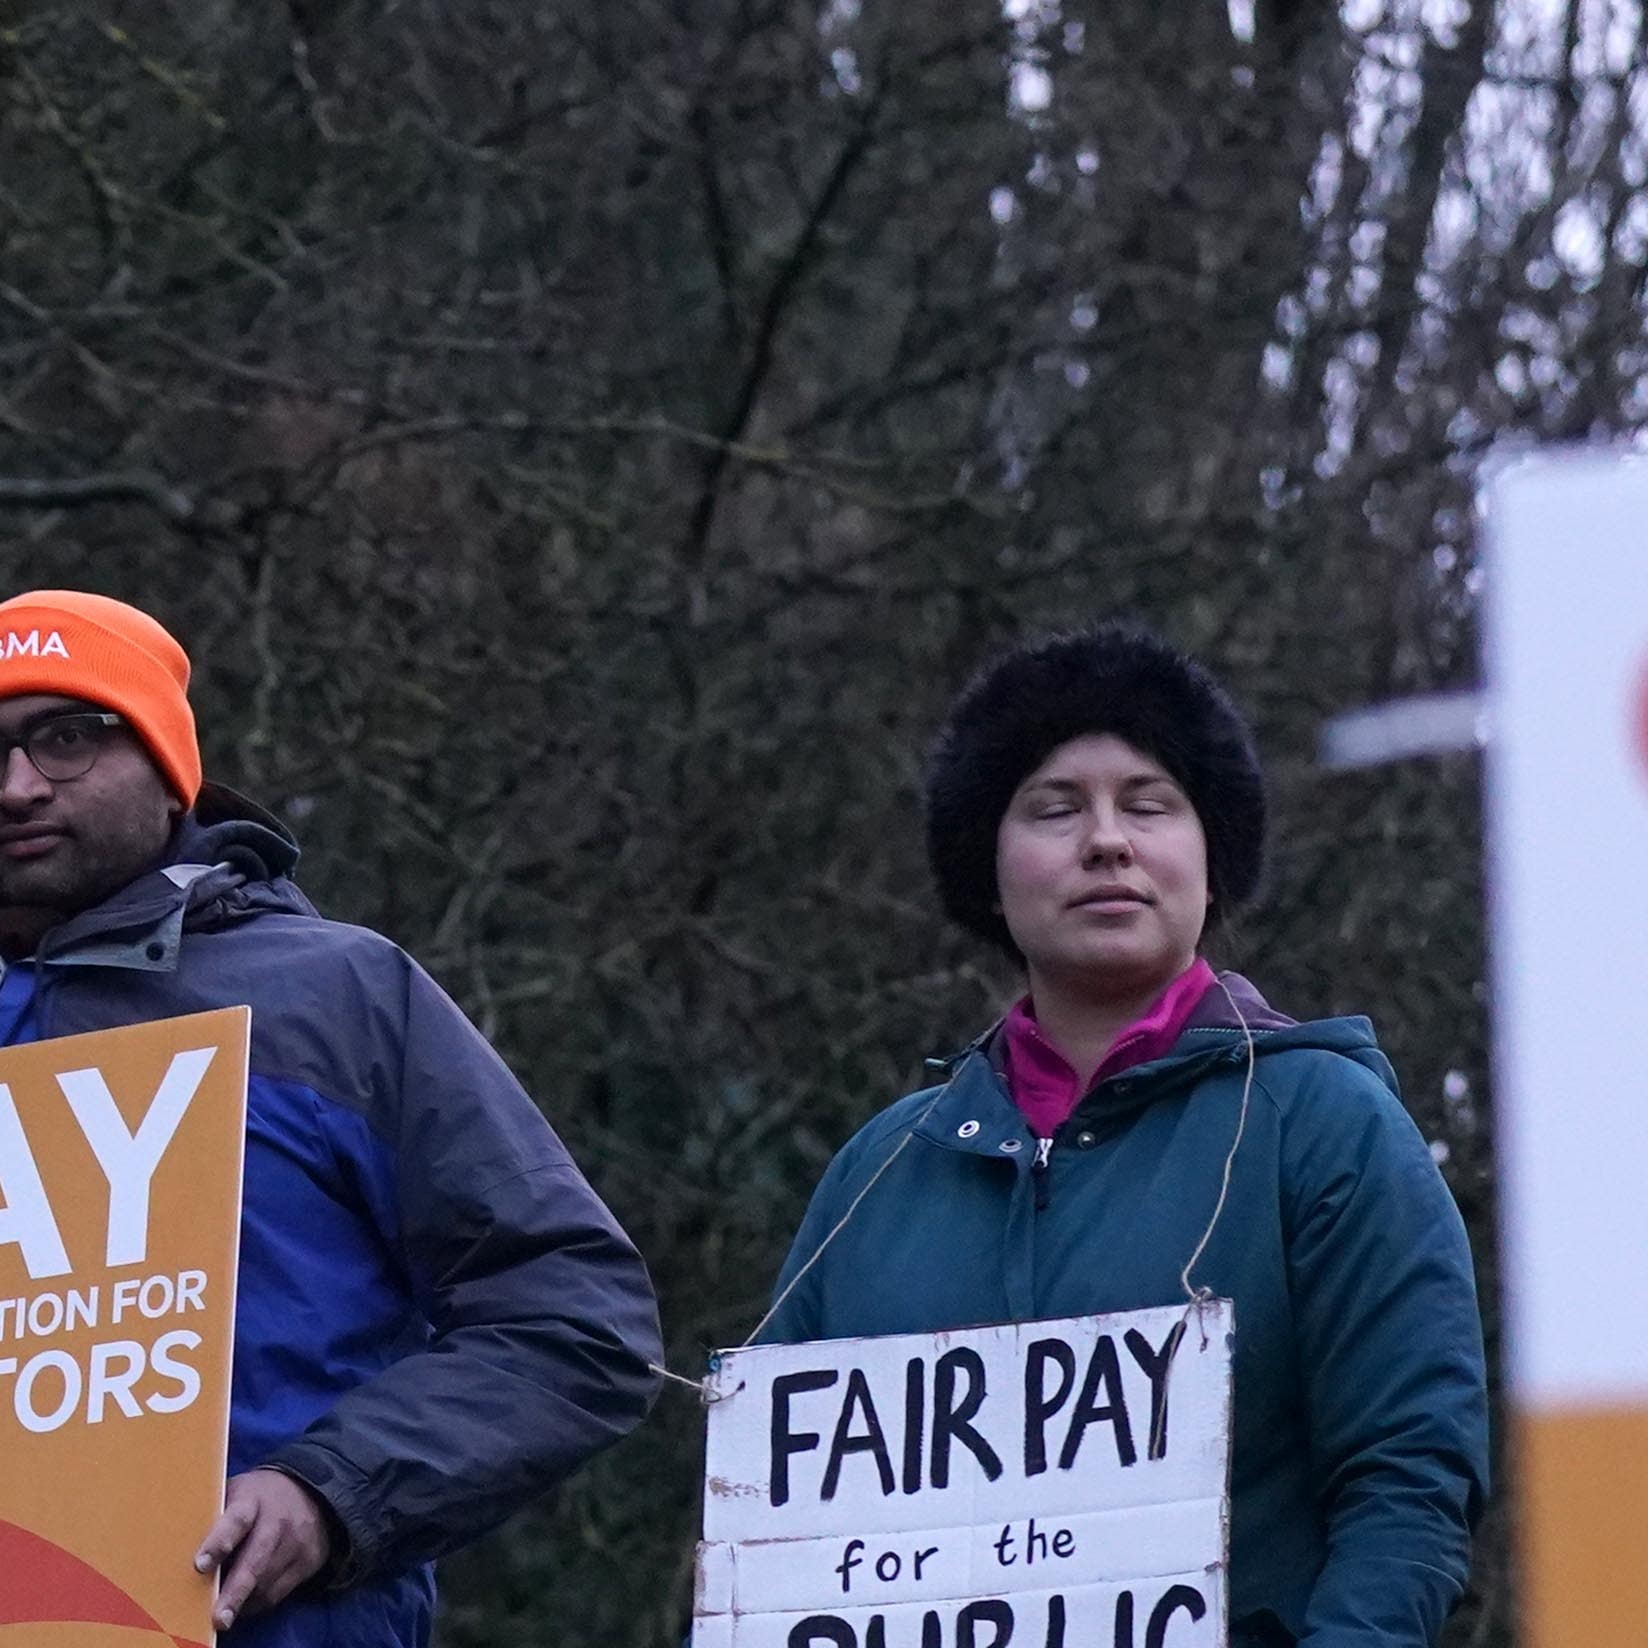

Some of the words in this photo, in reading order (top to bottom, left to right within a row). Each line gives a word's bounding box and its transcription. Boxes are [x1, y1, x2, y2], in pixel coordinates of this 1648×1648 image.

[110, 1269, 207, 1325] FOR
[769, 1346, 1003, 1507] FAIR
[1023, 1320, 1186, 1477] PAY
[835, 1539, 940, 1592] for
[994, 1519, 1076, 1566] the
